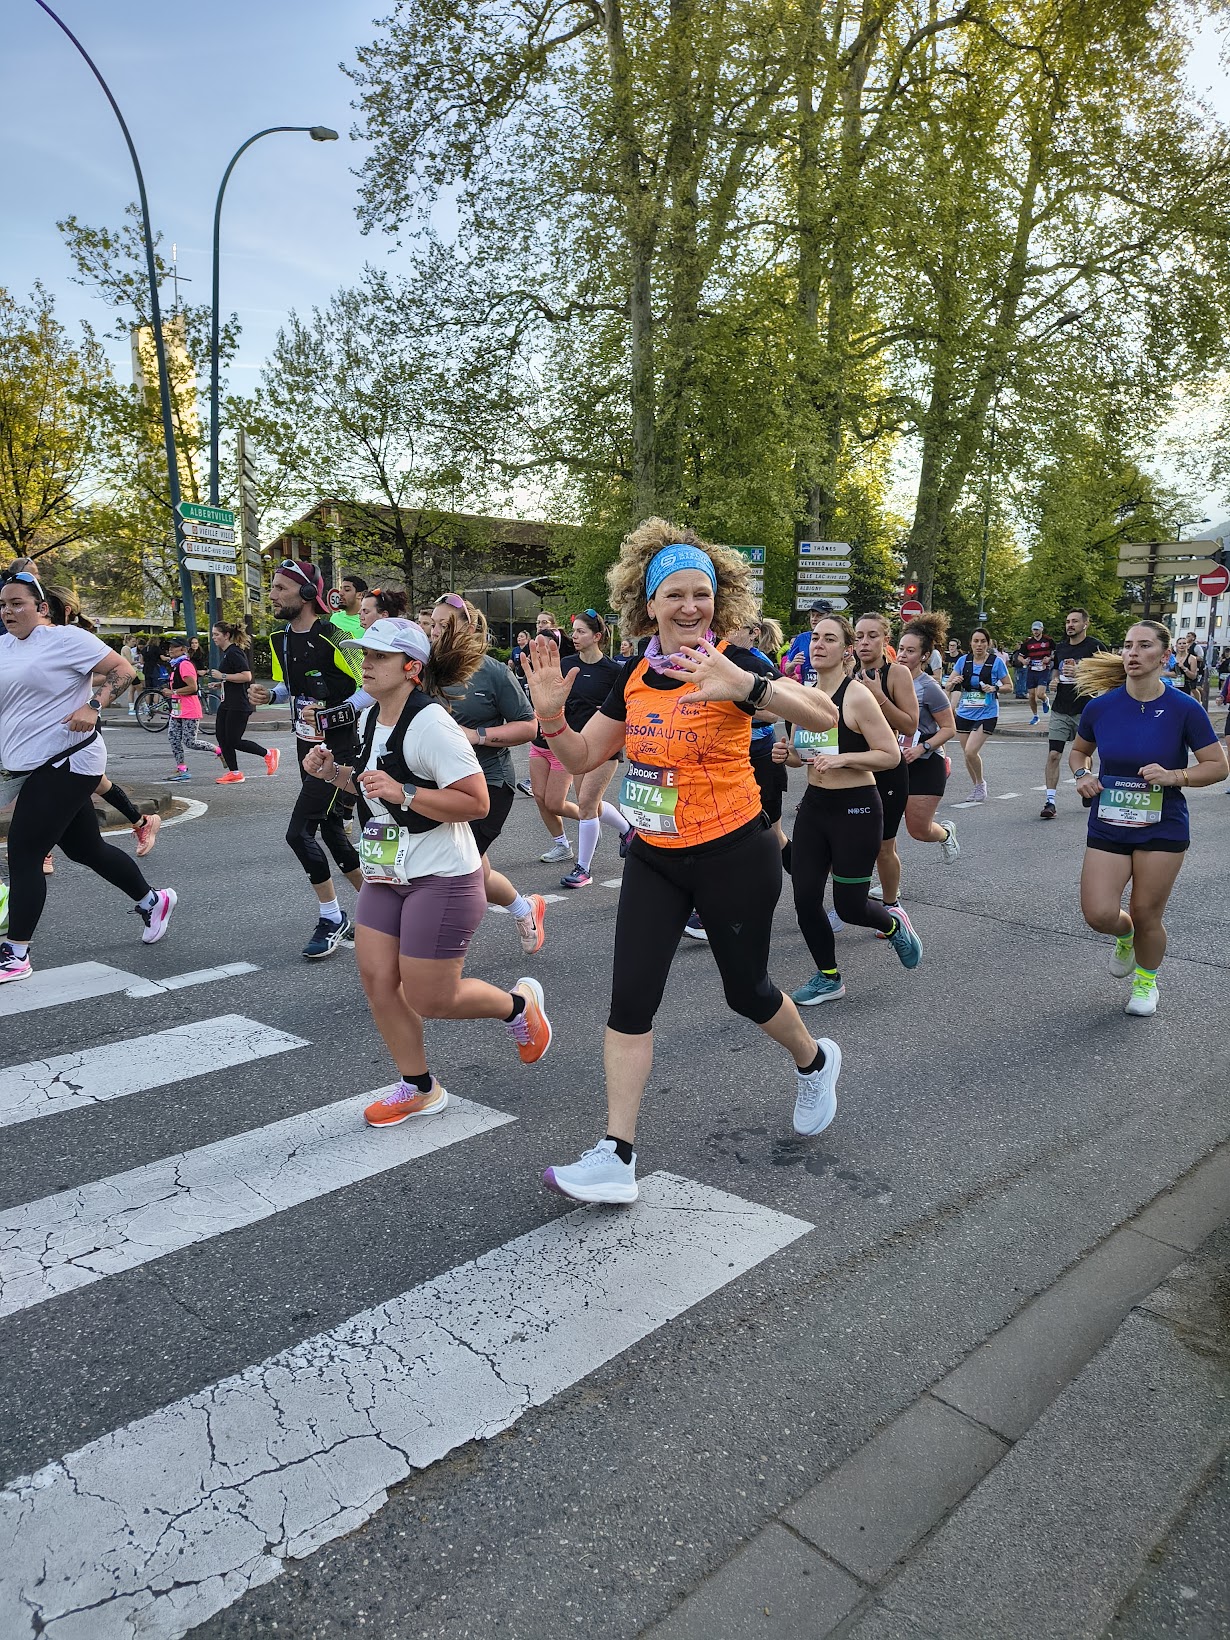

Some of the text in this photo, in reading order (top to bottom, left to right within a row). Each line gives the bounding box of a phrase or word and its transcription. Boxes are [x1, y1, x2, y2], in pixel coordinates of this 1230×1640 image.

[190, 508, 232, 522] ALBERTVILLE
[200, 529, 234, 540] VIEILLE VILLE
[223, 565, 236, 573] PORT
[807, 673, 817, 681] 143
[799, 731, 829, 744] 10645
[640, 741, 658, 754] Ford
[628, 762, 674, 787] BROOKS E
[625, 780, 663, 807] 13774
[1152, 784, 1161, 792] D
[1109, 790, 1151, 806] 10995
[386, 828, 397, 840] D
[360, 840, 384, 859] 154
